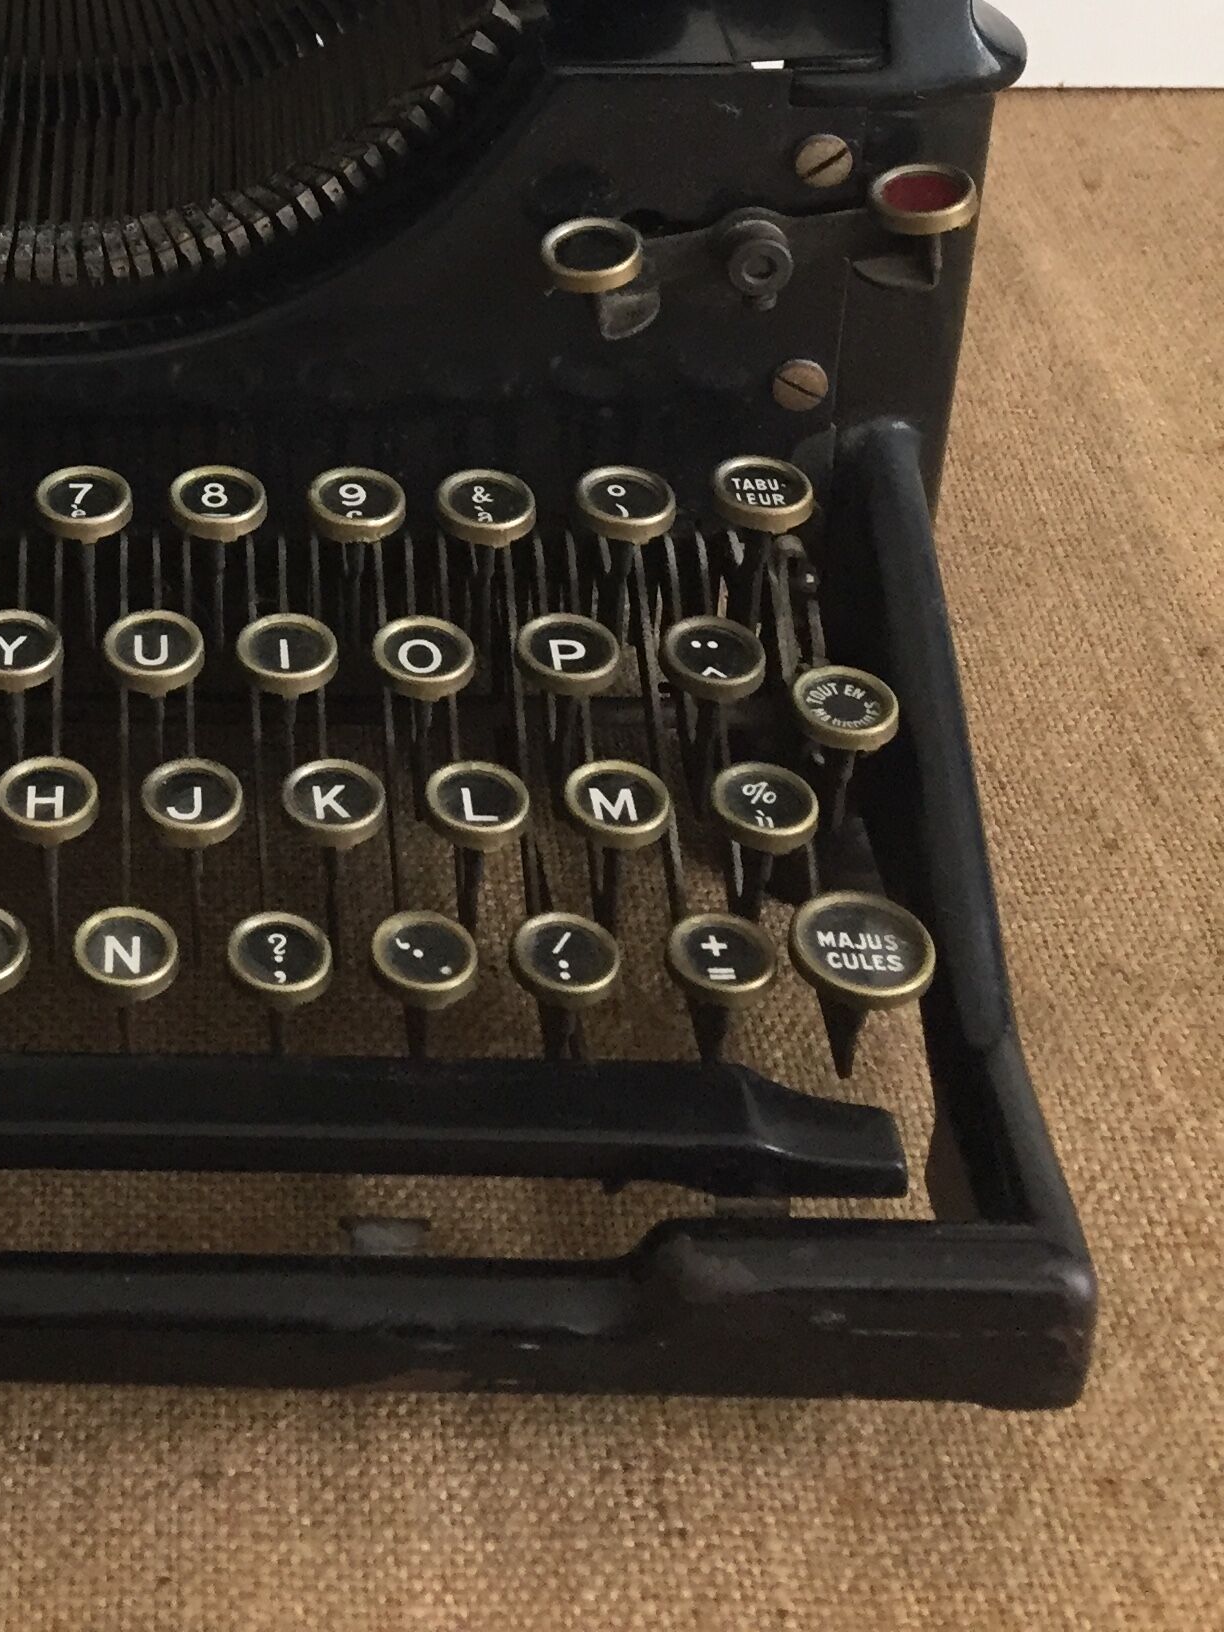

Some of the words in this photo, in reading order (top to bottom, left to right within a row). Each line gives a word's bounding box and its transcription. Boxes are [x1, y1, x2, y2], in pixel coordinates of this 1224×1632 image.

[68, 483, 93, 505] 7
[201, 482, 228, 508] 8
[338, 483, 367, 507] 9
[471, 485, 494, 504] &
[133, 634, 169, 667] U
[279, 638, 290, 669] I
[397, 639, 443, 674] O
[548, 639, 586, 671] P
[25, 785, 65, 820] H
[166, 785, 203, 821] J
[312, 784, 351, 820] K
[460, 787, 499, 822] L
[588, 787, 638, 822] M
[741, 781, 777, 805] %
[103, 935, 141, 974] N
[826, 952, 905, 972] CULES
